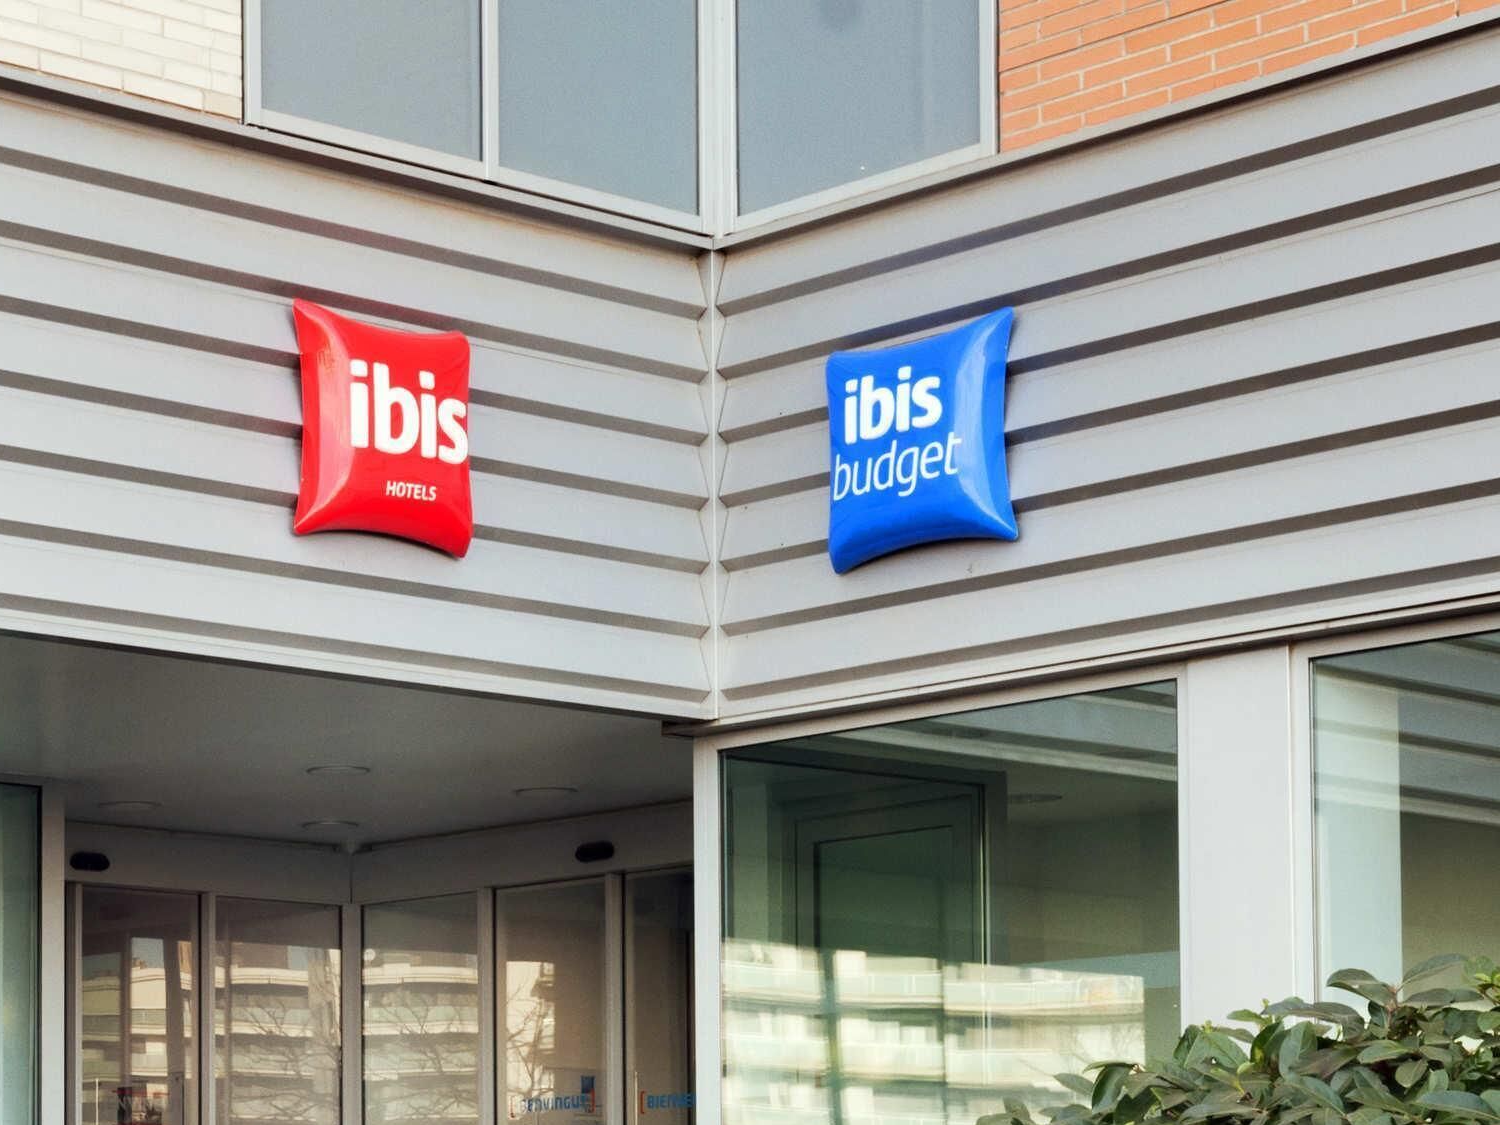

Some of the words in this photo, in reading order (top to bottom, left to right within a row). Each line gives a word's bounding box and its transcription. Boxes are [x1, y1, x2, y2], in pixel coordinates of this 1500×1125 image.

[350, 359, 469, 465] ibis
[844, 366, 943, 445] ibis
[386, 480, 437, 501] HOTELS
[833, 432, 962, 501] budget
